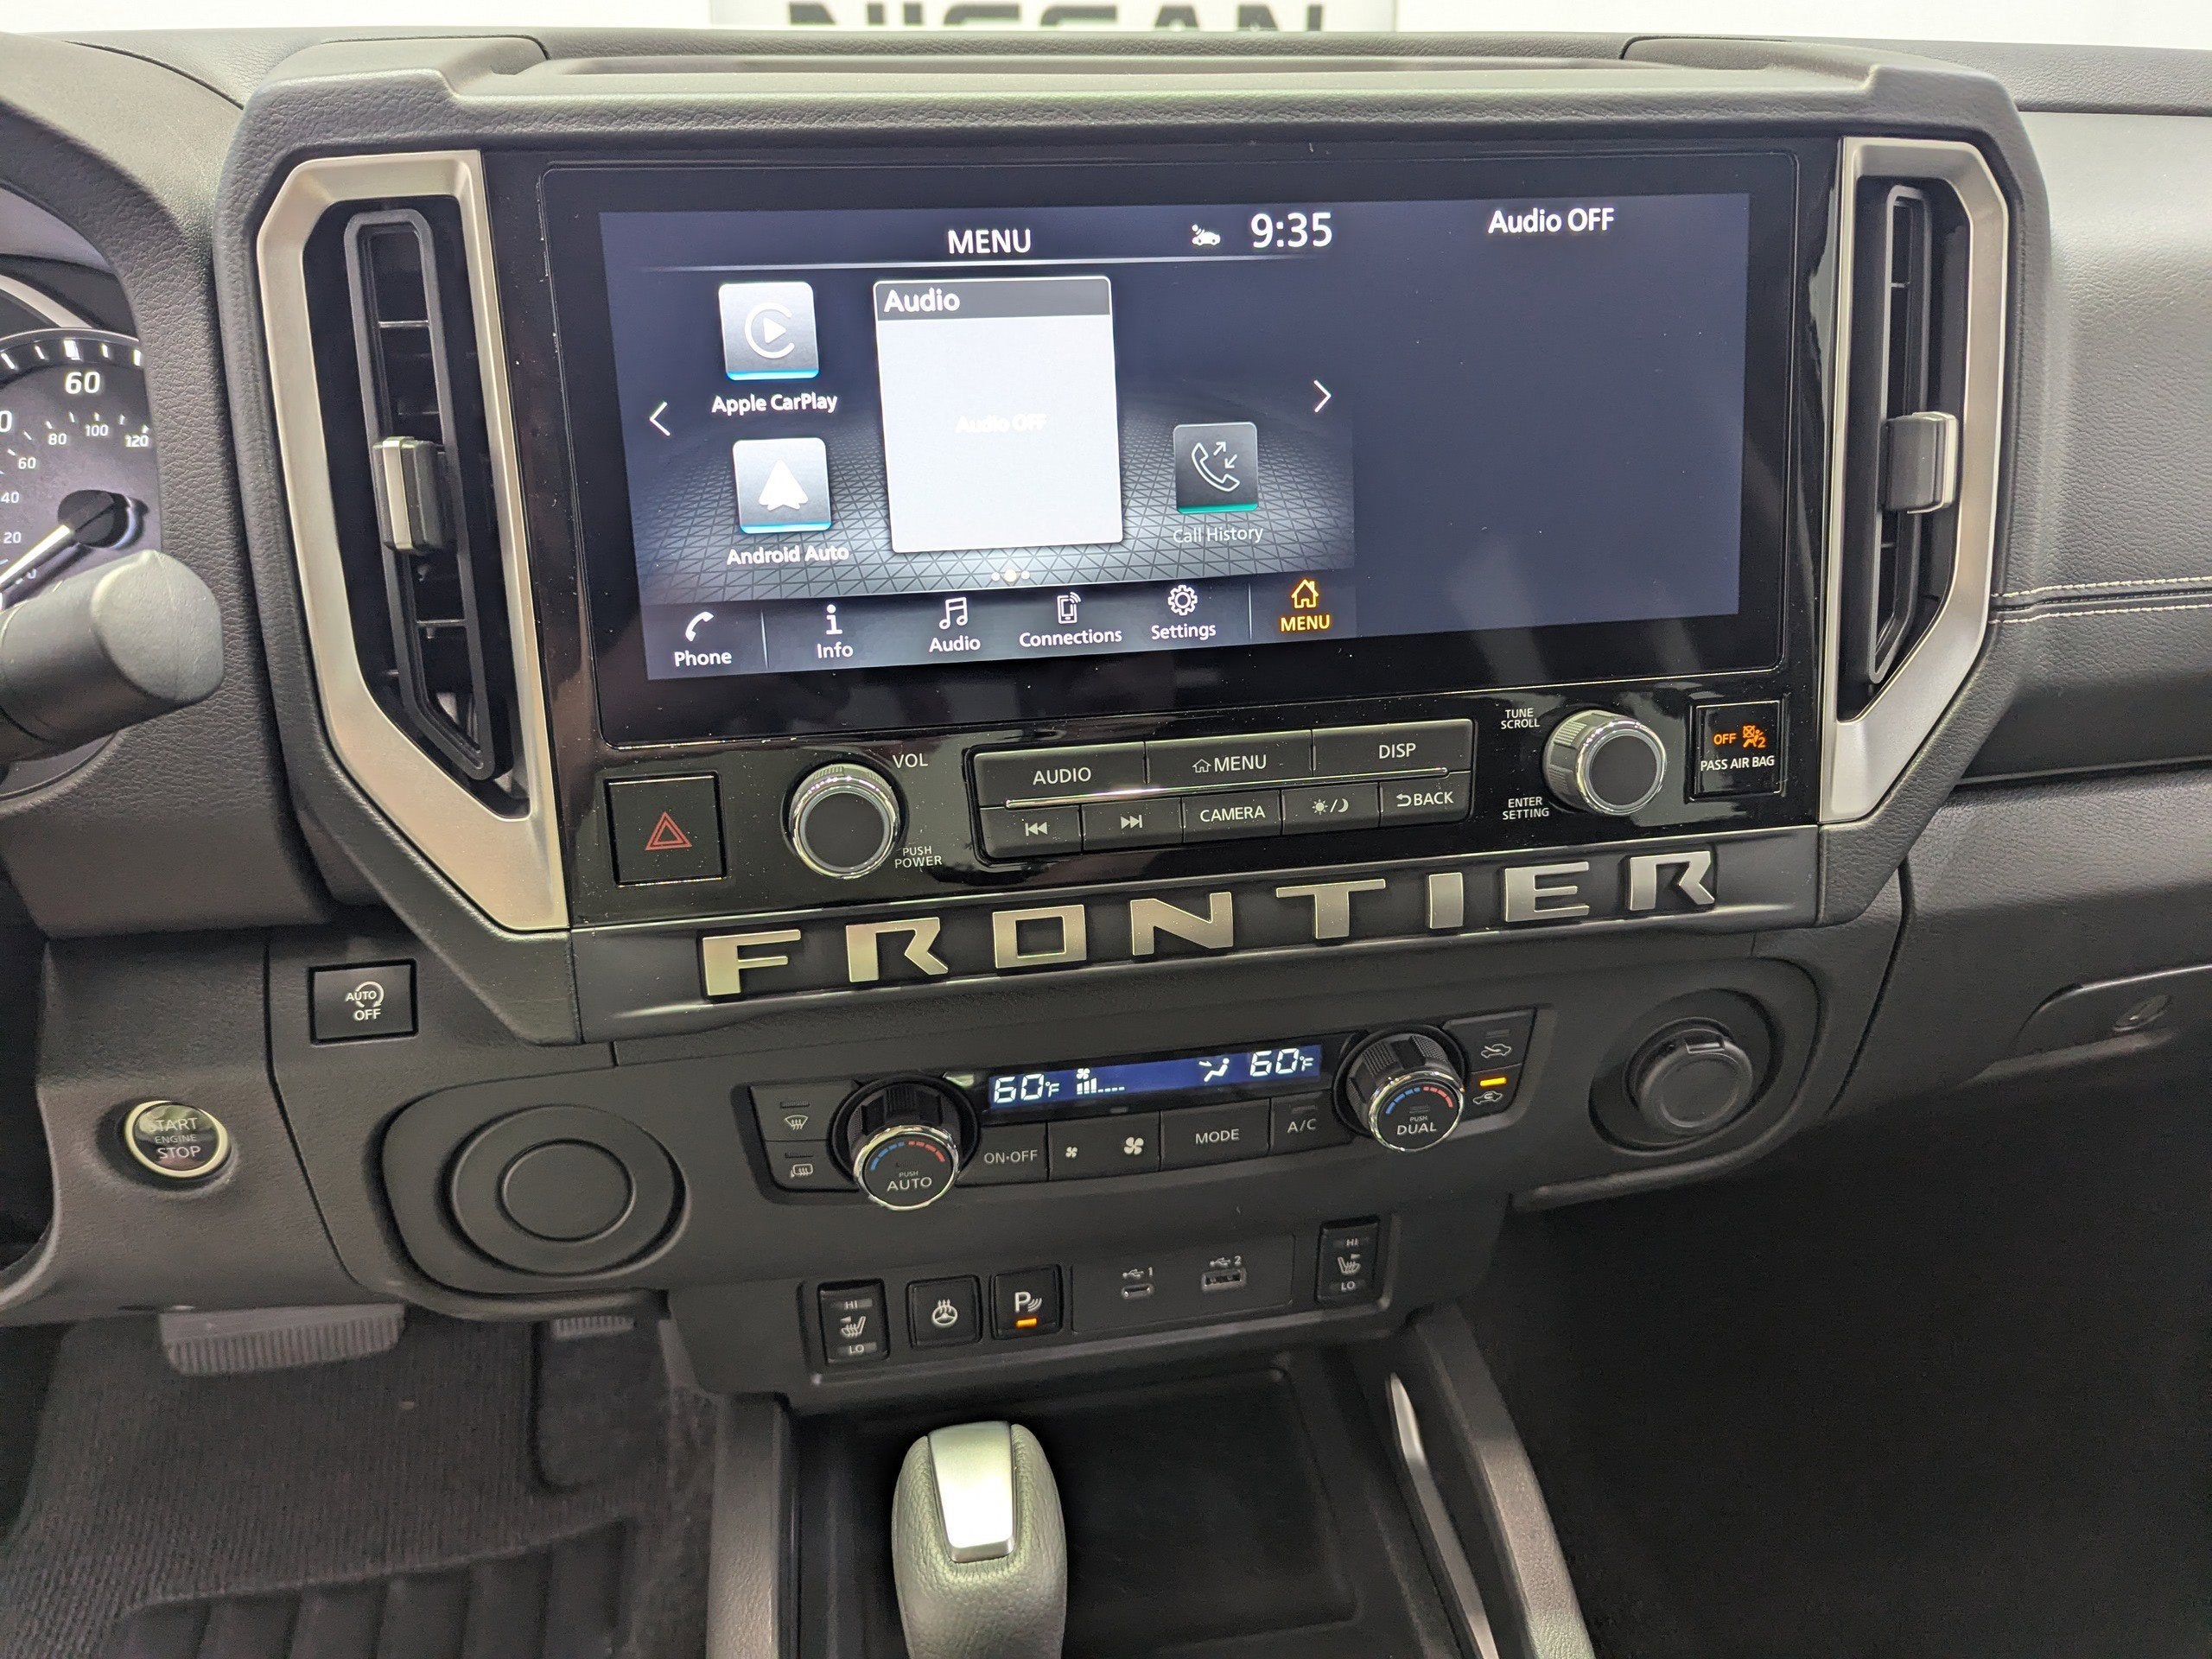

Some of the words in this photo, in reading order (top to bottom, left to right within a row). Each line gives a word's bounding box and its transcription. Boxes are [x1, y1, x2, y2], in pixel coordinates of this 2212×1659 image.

[1487, 209, 1562, 234] Audio
[1567, 207, 1616, 232] OFF
[1249, 211, 1334, 249] 9:35
[947, 229, 1033, 255] MENU
[883, 289, 961, 314] Audio
[65, 371, 102, 394] 60
[711, 395, 767, 416] Apple
[770, 391, 838, 413] CarPlay
[85, 424, 110, 437] 100
[956, 416, 1010, 434] Audio
[1013, 413, 1047, 431] OFF
[48, 433, 67, 446] 80
[125, 435, 149, 448] 120
[17, 457, 37, 470] 60
[0, 490, 21, 504] 40
[3, 531, 22, 544] 20
[1172, 528, 1204, 545] Call
[1206, 525, 1264, 547] History
[726, 547, 801, 566] Android
[804, 543, 850, 562] Auto
[1280, 613, 1332, 632] MENU
[1019, 629, 1123, 648] Connections
[1150, 624, 1217, 643] Settings
[817, 641, 855, 660] Info
[928, 635, 982, 654] Audio
[674, 651, 734, 668] Phone
[1504, 708, 1535, 720] TUNE
[1500, 717, 1541, 730] SCROLL
[1712, 733, 1738, 747] OFF
[1377, 742, 1418, 761] DISP
[891, 753, 930, 769] VOL
[1213, 754, 1268, 773] MENU
[1700, 760, 1729, 772] PASS
[1730, 758, 1751, 770] AIR
[1753, 755, 1777, 768] BAG
[1032, 766, 1093, 786] AUDIO
[1414, 790, 1455, 807] BACK
[1507, 796, 1544, 809] ENTER
[1199, 805, 1267, 823] CAMERA
[1502, 807, 1551, 821] SETTING
[902, 845, 933, 857] PUSH
[893, 855, 944, 869] POWER
[702, 849, 1719, 997] FRONTIER
[345, 990, 378, 1002] AUTO
[353, 1007, 382, 1021] OFF
[1286, 1117, 1318, 1135] A/C
[1395, 1122, 1438, 1136] DUAL
[154, 1133, 198, 1145] ENGINE
[1194, 1128, 1242, 1146] MODE
[156, 1145, 202, 1160] STOP
[898, 1170, 919, 1179] PUSH
[887, 1176, 933, 1193] AUTO
[1346, 1238, 1359, 1247] HI
[1340, 1281, 1357, 1291] LO
[843, 1300, 859, 1310] HI
[849, 1344, 865, 1355] LO
